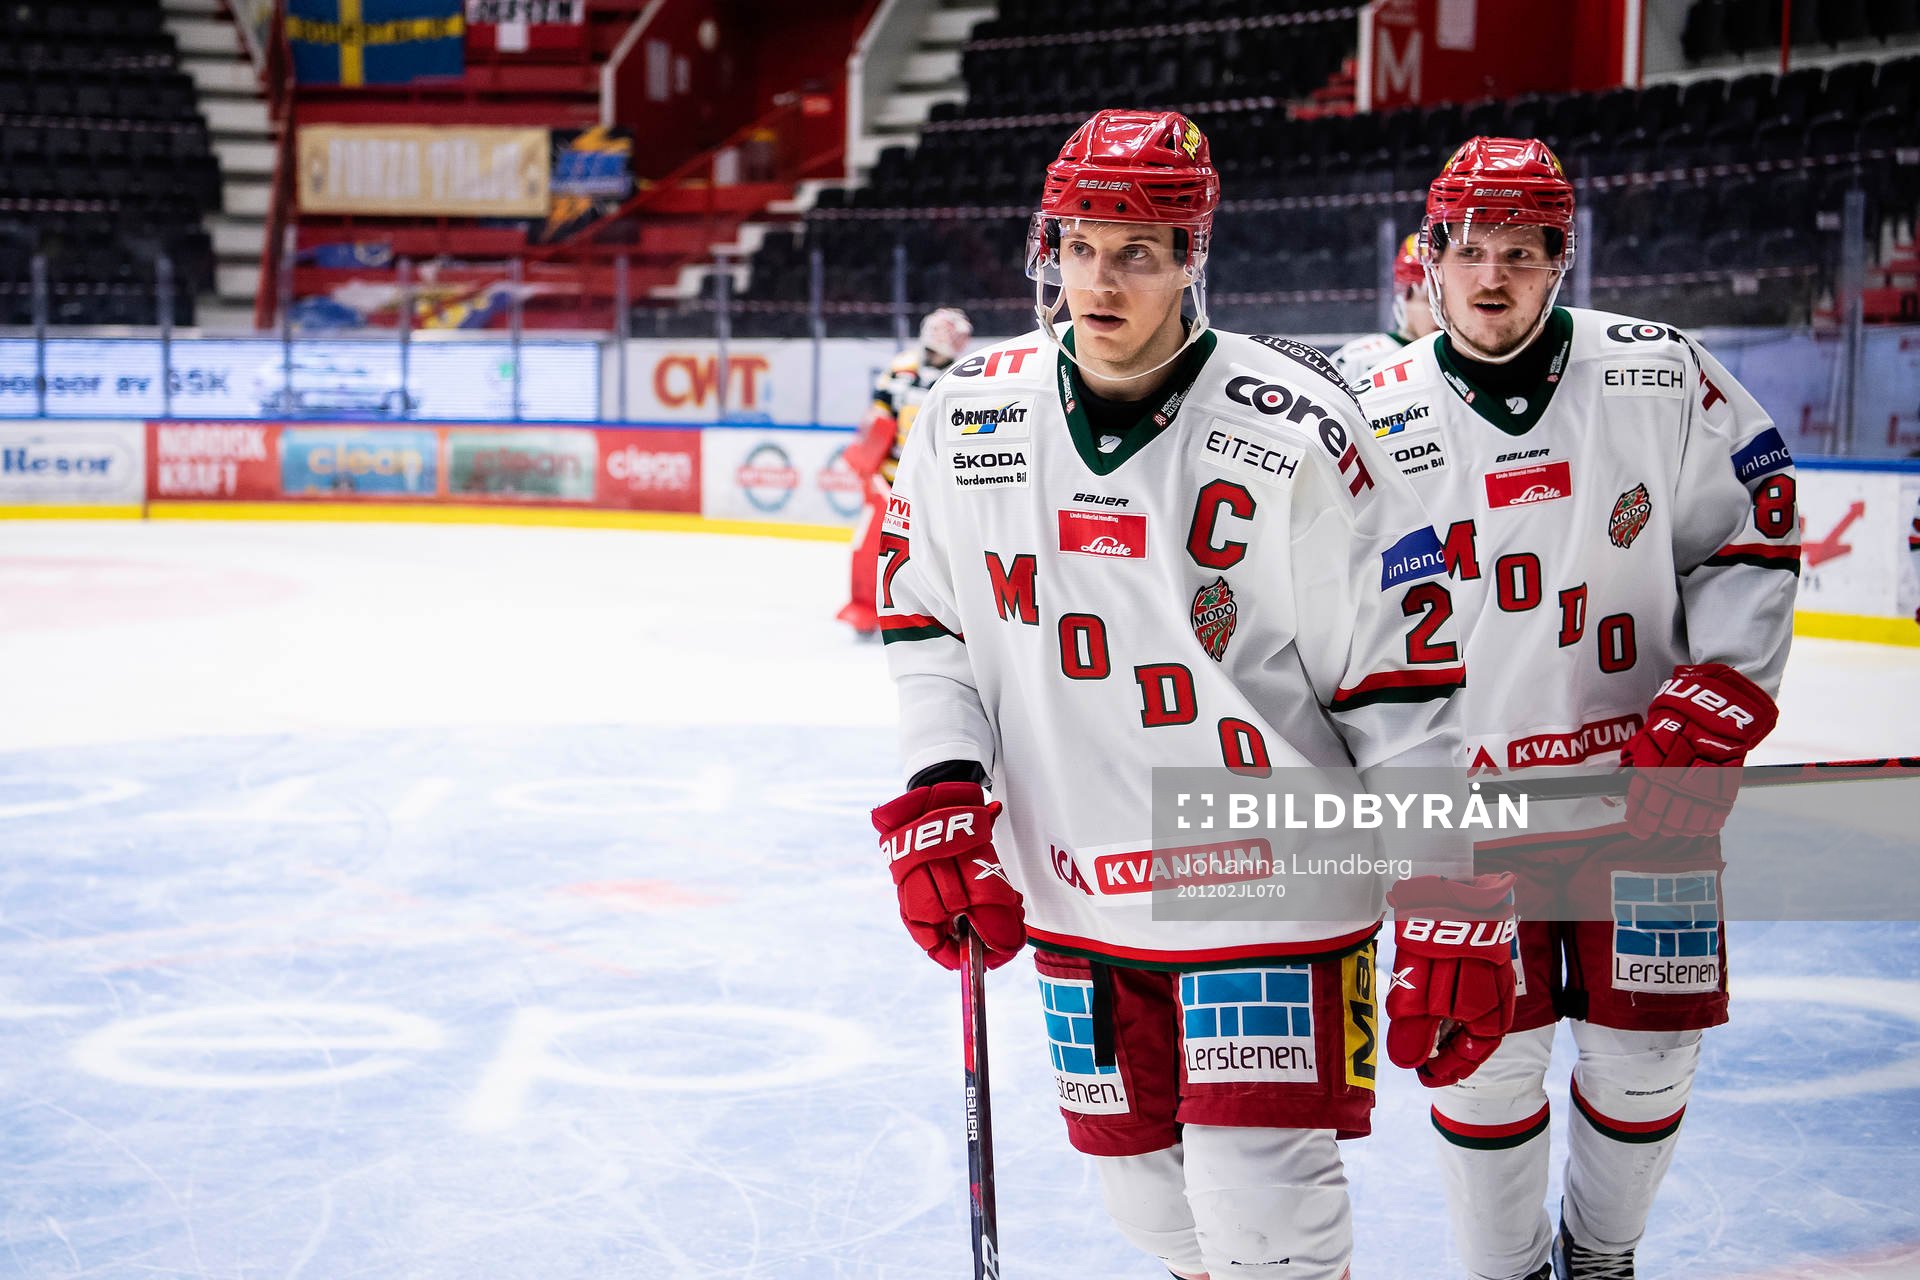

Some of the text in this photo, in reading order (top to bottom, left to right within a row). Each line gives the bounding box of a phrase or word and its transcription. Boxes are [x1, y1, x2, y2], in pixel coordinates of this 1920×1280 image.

[1378, 30, 1421, 102] M
[1076, 179, 1132, 191] BAUER
[1473, 188, 1522, 198] BAUER
[653, 354, 769, 409] CWT
[953, 452, 1027, 469] ŠKODA
[1391, 442, 1441, 464] ODA
[1430, 456, 1445, 469] Bil
[1495, 448, 1550, 463] BAUER
[956, 471, 1027, 487] Nordemans Bil
[1072, 493, 1130, 508] BAUER
[1509, 484, 1561, 505] Linde
[1186, 478, 1257, 571] C
[1612, 503, 1648, 529] MODO
[1080, 536, 1132, 556] Linde
[1194, 603, 1235, 627] MODO
[1515, 721, 1637, 764] KVANTUM
[966, 1086, 979, 1142] BAUER
